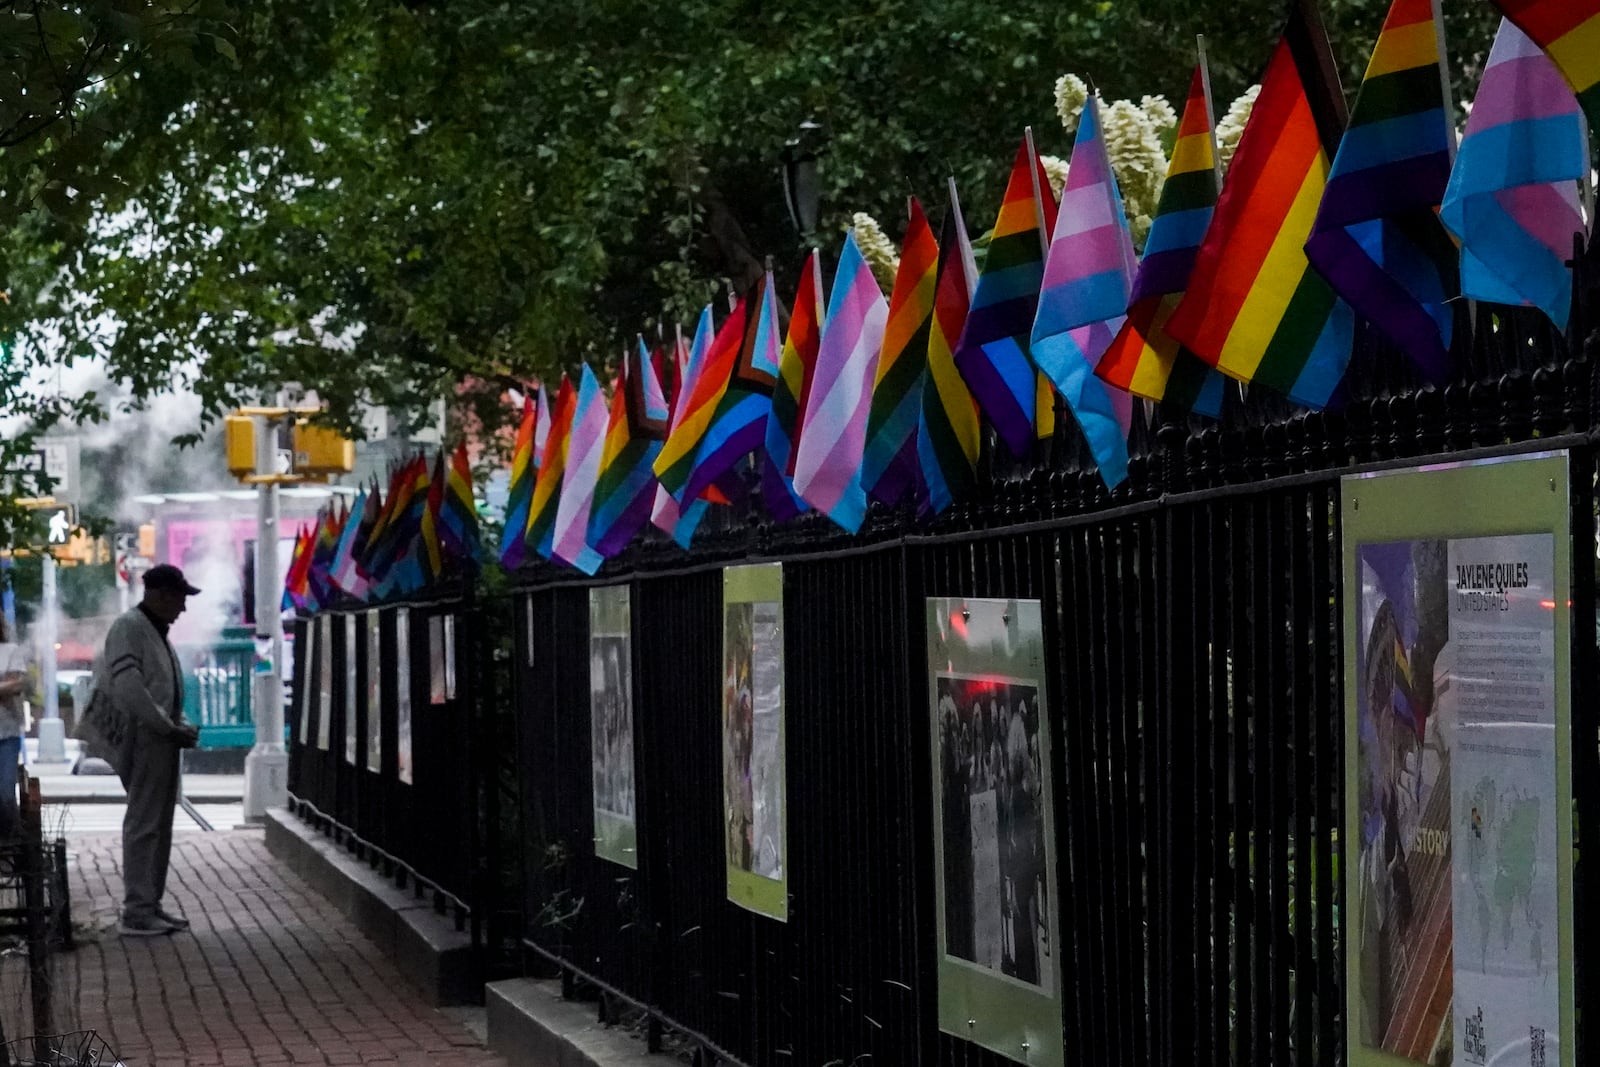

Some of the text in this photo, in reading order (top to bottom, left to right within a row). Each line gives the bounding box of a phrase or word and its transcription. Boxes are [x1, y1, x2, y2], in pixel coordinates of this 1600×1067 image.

[1456, 562, 1529, 593] JAYLENE QUILES
[1456, 591, 1509, 612] UNITED STATES
